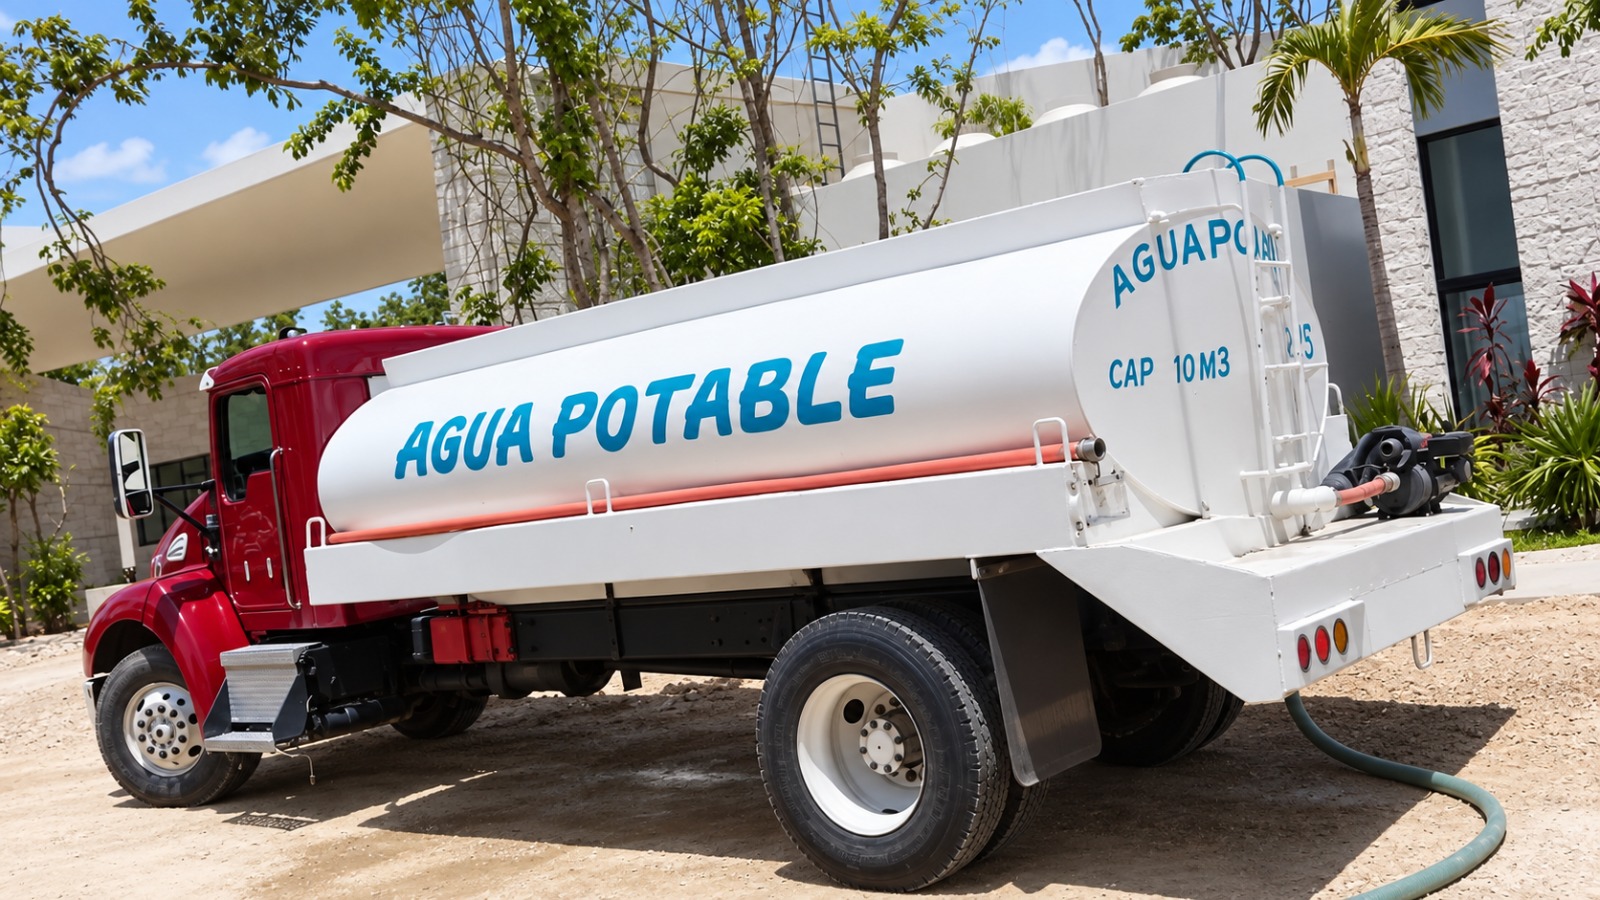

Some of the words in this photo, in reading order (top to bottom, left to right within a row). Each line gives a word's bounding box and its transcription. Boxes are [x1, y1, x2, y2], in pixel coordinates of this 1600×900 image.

[394, 401, 534, 480] AGUA
[551, 338, 905, 459] POTABLE
[1109, 357, 1154, 389] CAP
